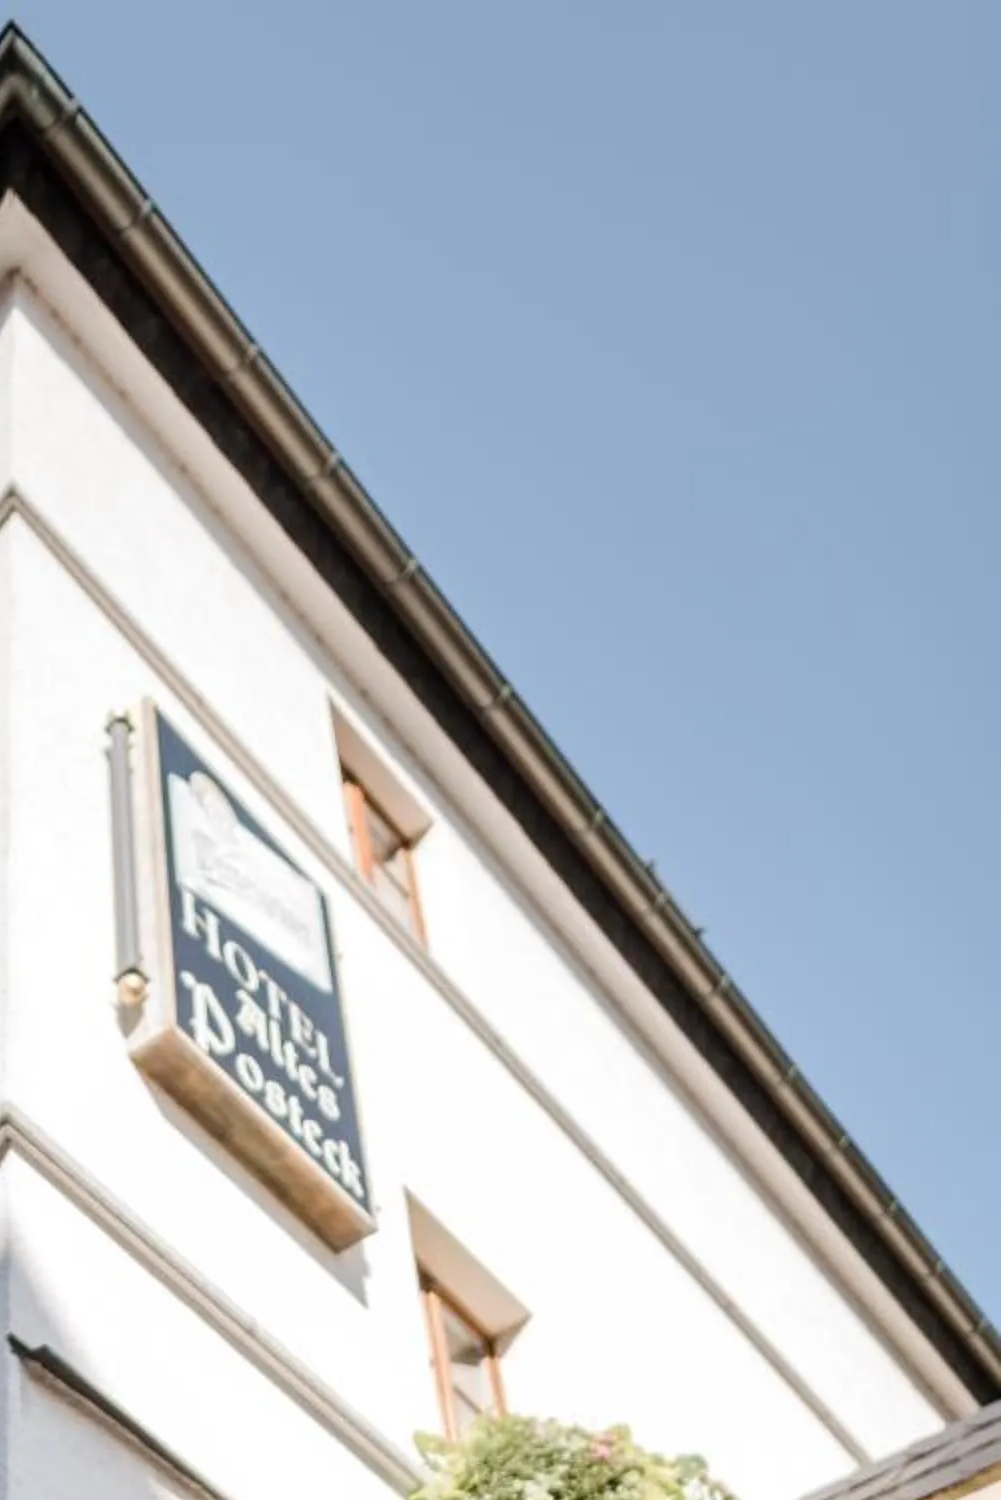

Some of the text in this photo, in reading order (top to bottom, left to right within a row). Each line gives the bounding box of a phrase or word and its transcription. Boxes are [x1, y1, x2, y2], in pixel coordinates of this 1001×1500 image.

[179, 969, 365, 1199] Posteck
[180, 889, 345, 1088] HOTEL
[235, 988, 341, 1122] Altes
